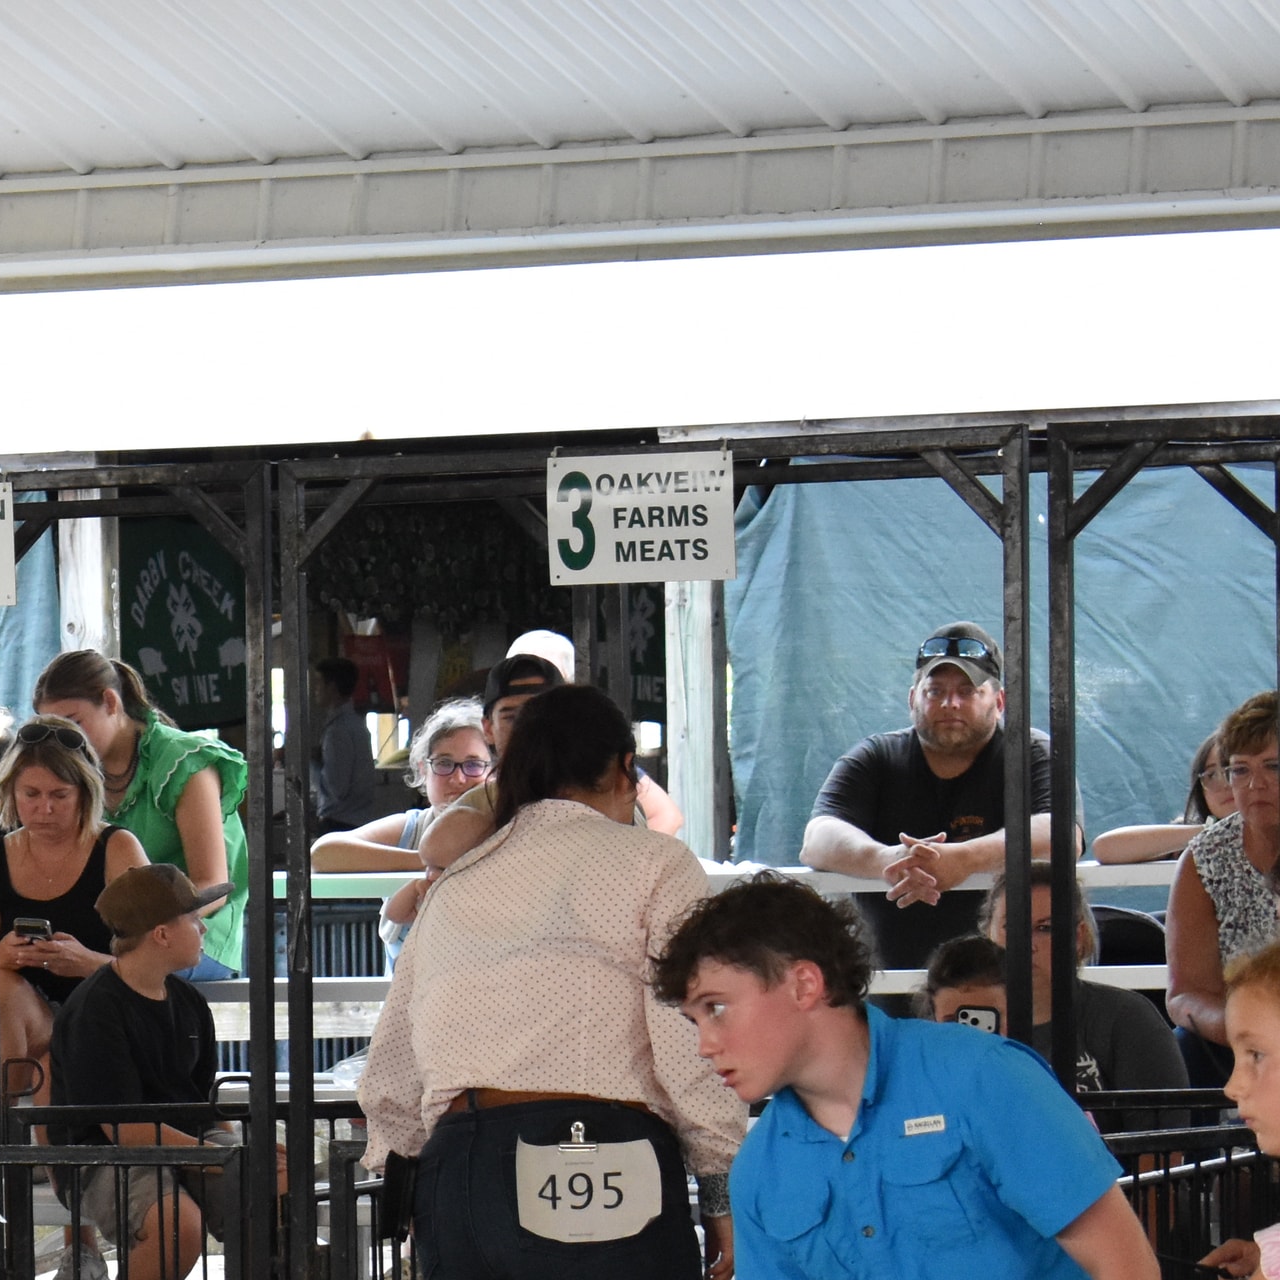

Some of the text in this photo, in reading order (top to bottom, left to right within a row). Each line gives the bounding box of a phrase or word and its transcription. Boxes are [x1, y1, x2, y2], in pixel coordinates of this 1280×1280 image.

[595, 469, 726, 496] OAKVEIW
[556, 470, 596, 571] 3
[612, 504, 709, 529] FARMS
[614, 537, 709, 563] MEATS
[130, 549, 168, 630] DARBY
[537, 1171, 624, 1211] 495
